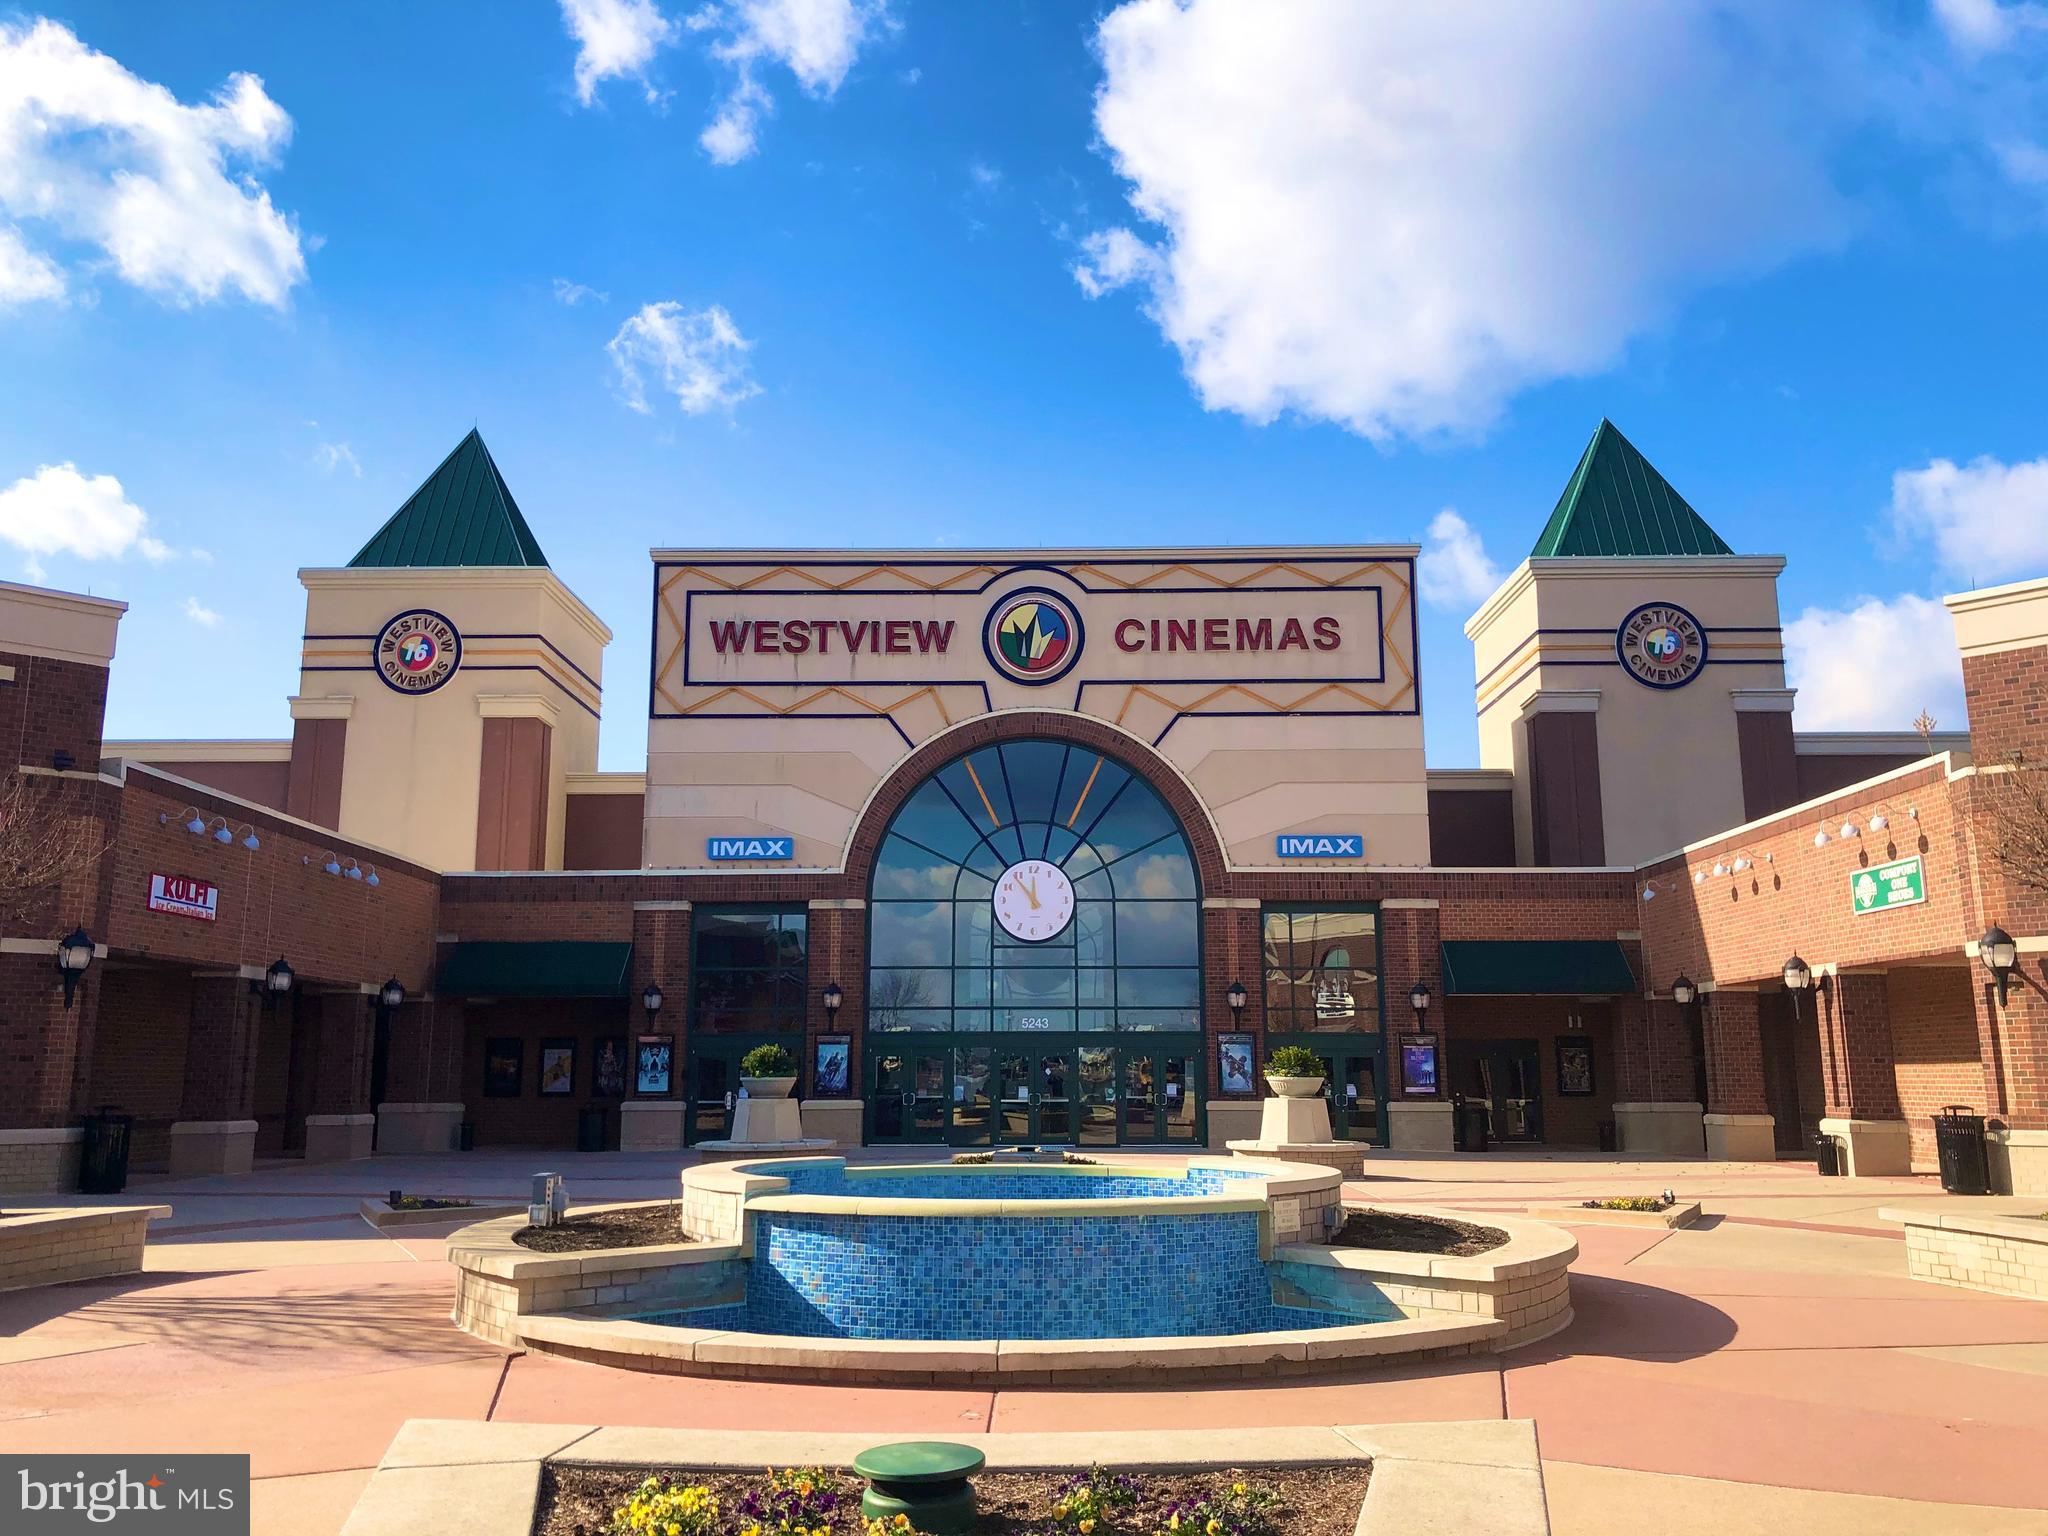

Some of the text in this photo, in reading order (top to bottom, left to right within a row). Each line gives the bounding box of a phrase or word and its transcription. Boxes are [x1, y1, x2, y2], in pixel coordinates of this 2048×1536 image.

[382, 617, 454, 653] WESTVIEW
[708, 616, 1342, 654] WESTVIEW CINEMAS
[1625, 610, 1699, 647] WESTVIEW
[405, 643, 428, 662] 16
[1653, 636, 1676, 655] 16
[384, 660, 449, 687] CINEMAS
[1630, 653, 1697, 681] CINEMAS
[712, 840, 786, 857] IMAX
[1281, 838, 1356, 854] IMAX
[163, 876, 208, 905] KULFI
[1022, 1017, 1049, 1029] 5243
